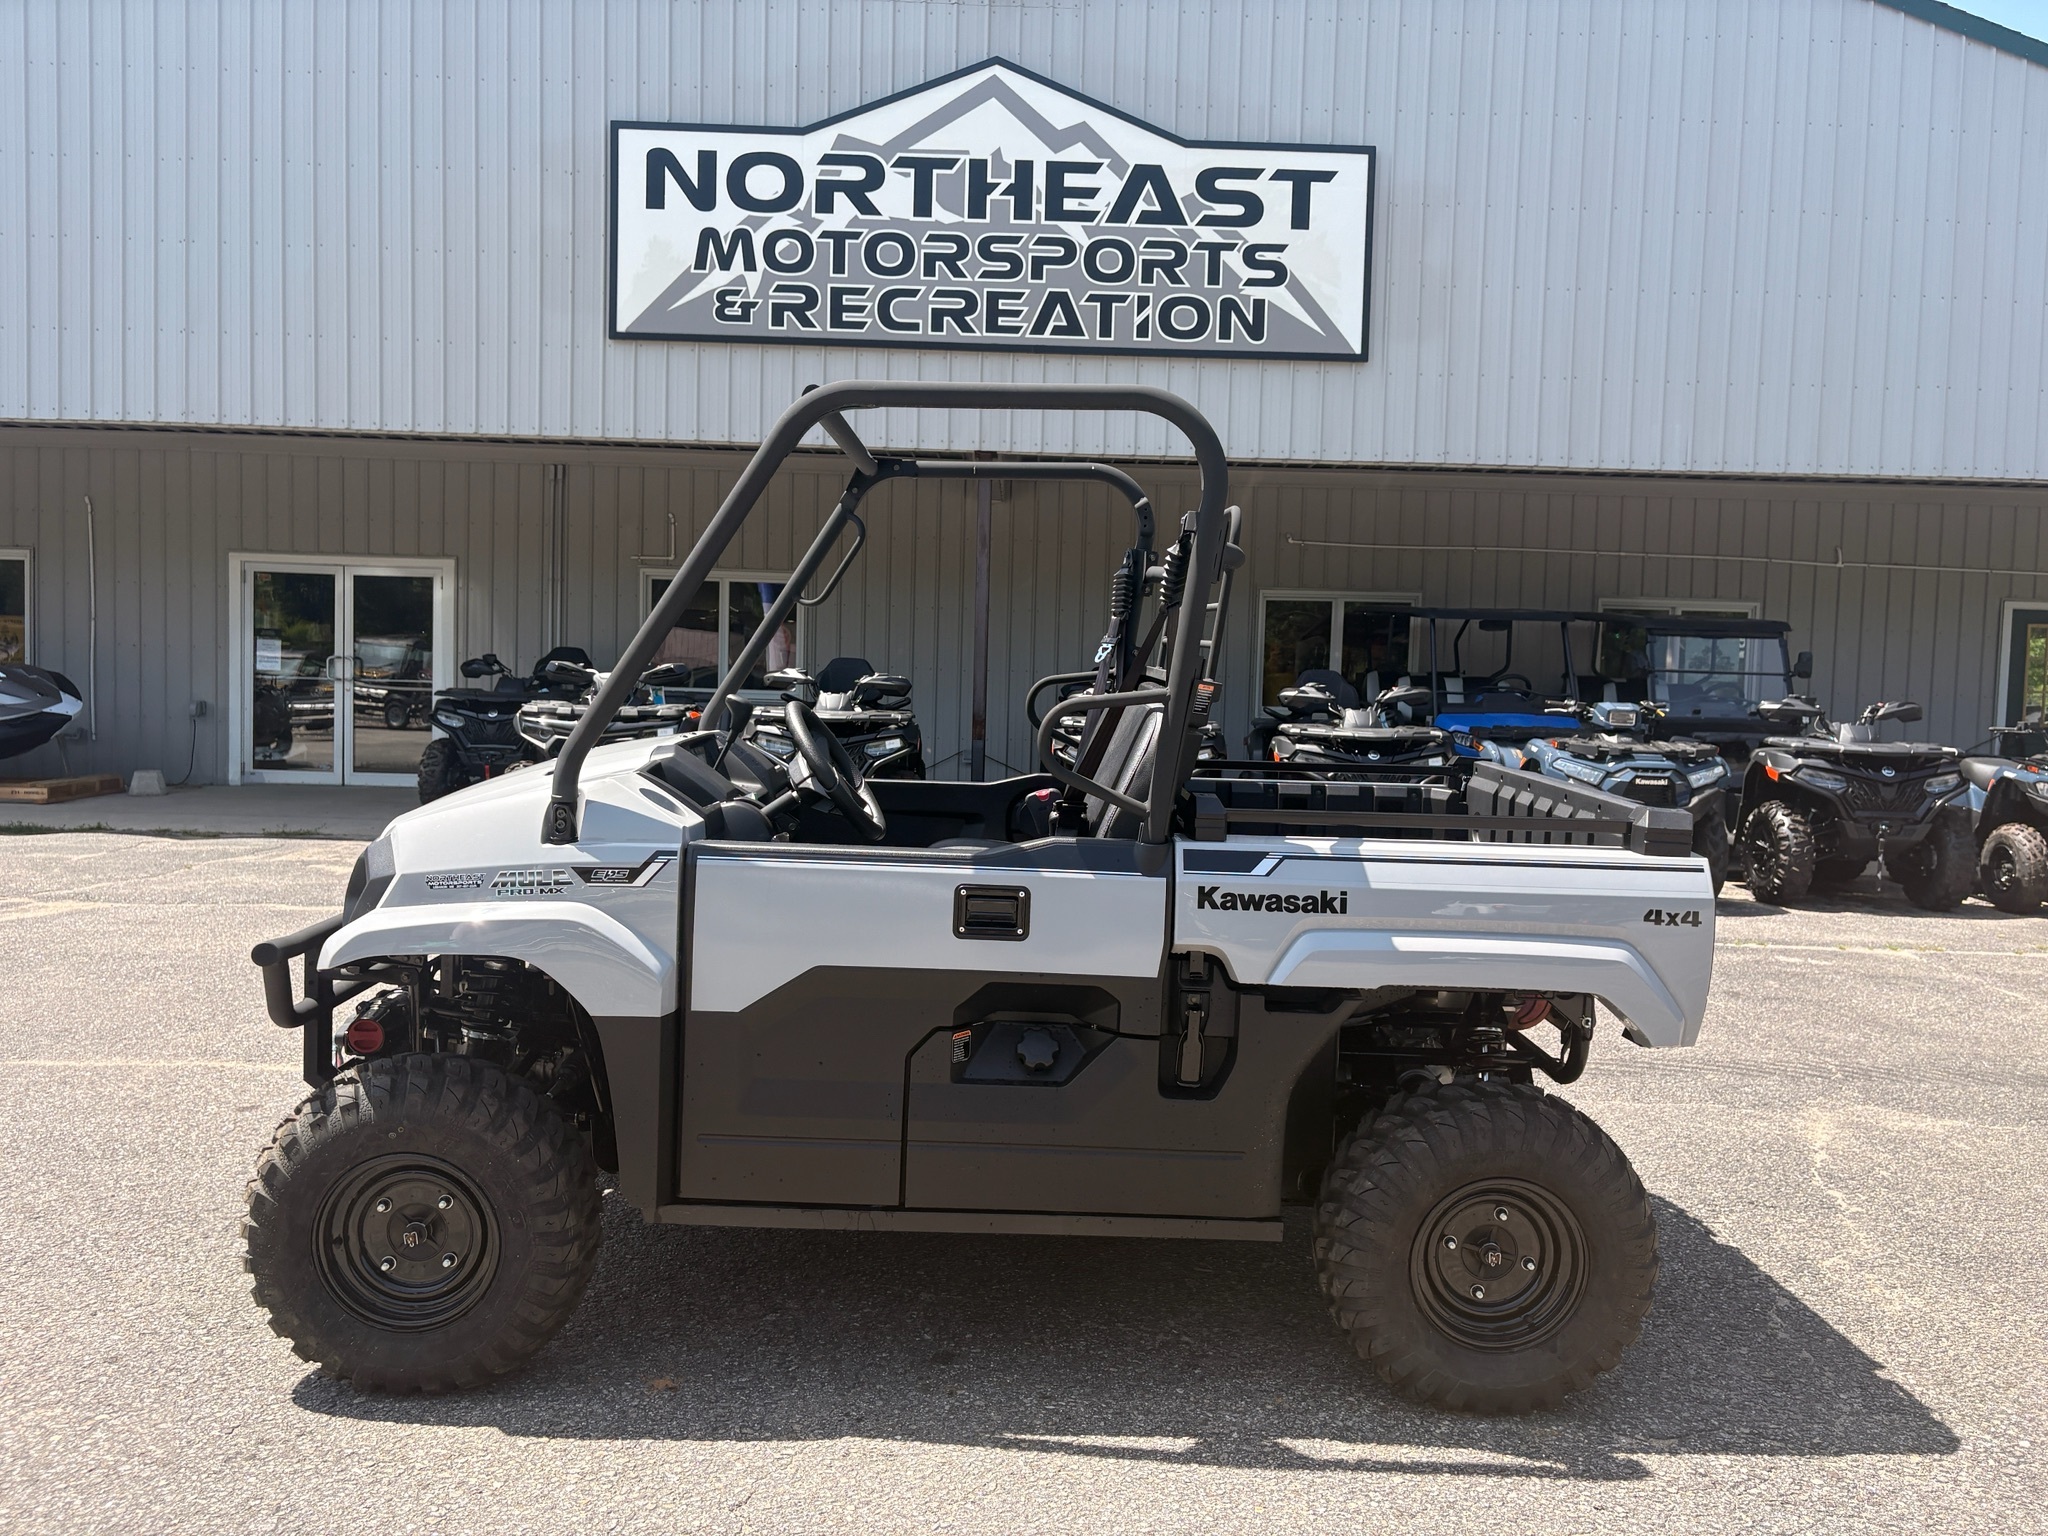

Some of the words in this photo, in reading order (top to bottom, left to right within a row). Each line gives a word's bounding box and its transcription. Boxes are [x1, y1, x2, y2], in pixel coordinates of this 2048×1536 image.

[644, 146, 1340, 231] NORTHEAST
[692, 226, 1290, 288] MOTORSPORTS
[1635, 778, 1668, 786] Kawasaki
[425, 872, 486, 882] NORTHEAST
[489, 869, 575, 888] MULE
[496, 887, 566, 896] PRO-MX
[1197, 886, 1348, 914] Kawasaki
[1643, 909, 1703, 927] 4x4
